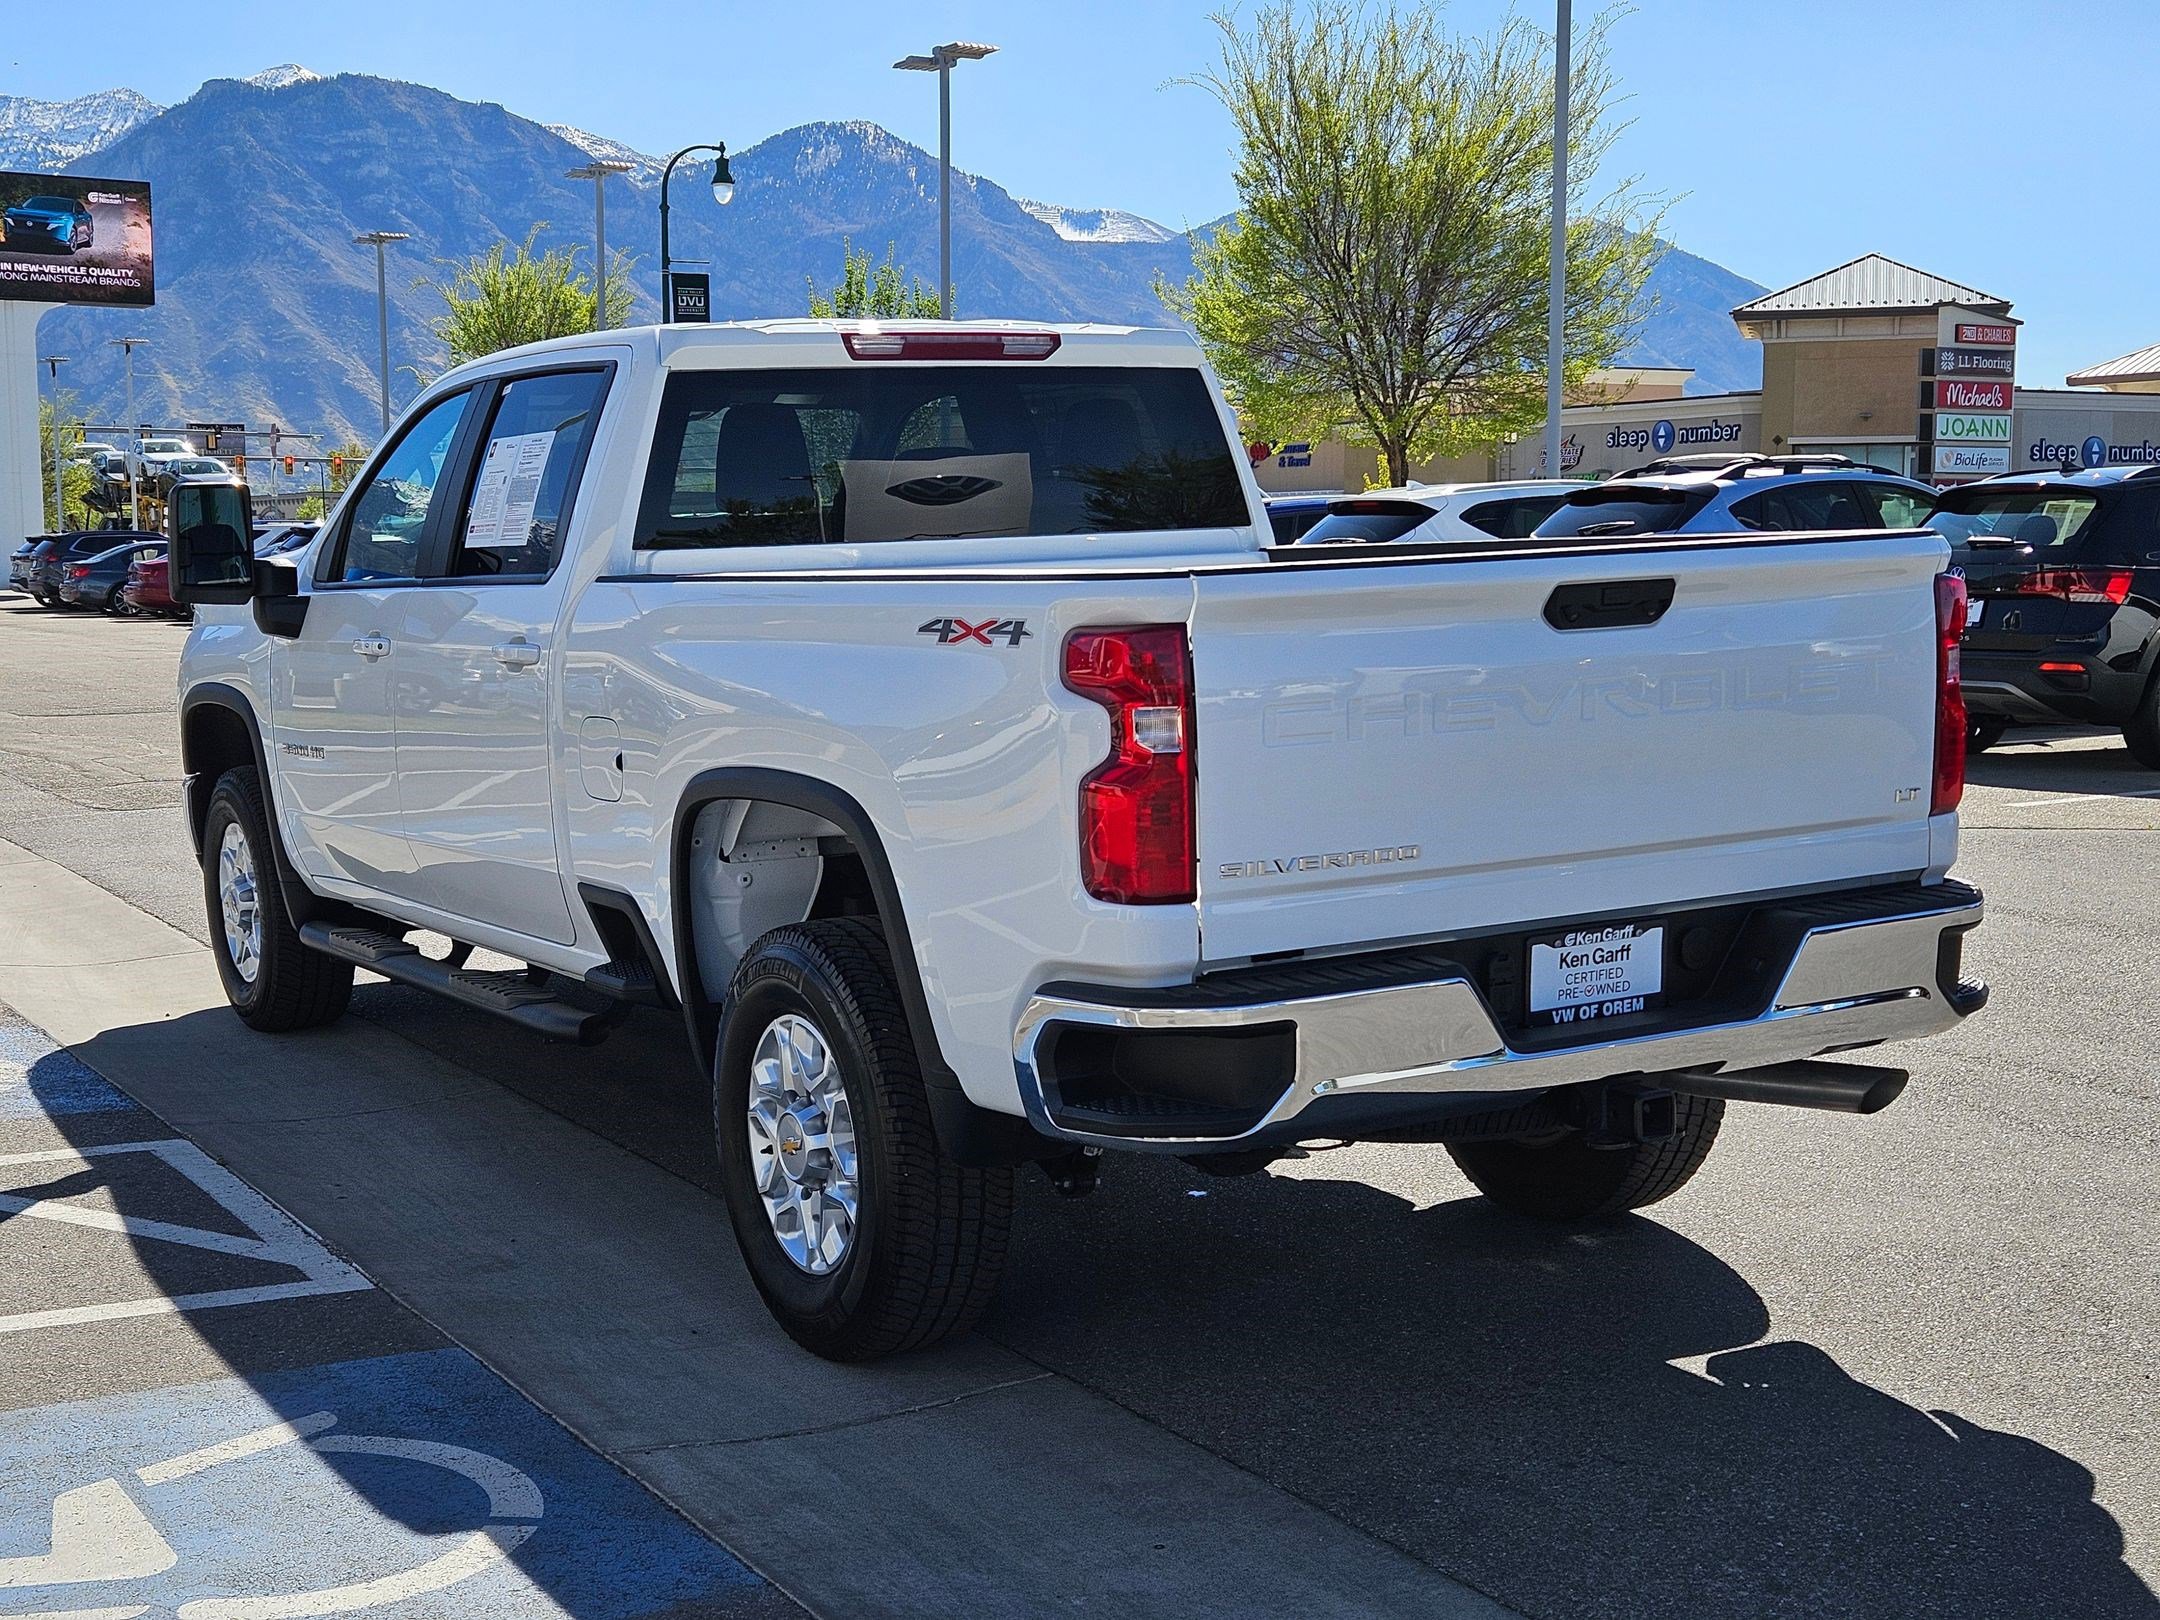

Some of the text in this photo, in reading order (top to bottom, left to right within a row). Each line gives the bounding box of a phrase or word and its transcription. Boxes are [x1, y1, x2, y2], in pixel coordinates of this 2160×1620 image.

[0, 262, 134, 278] IN NEW-VEHICLE QUALITY
[0, 271, 141, 287] MONG MAINSTREAM BRANDS
[678, 296, 704, 306] UVU
[1962, 326, 2011, 342] 2ND & CHARLES
[1958, 356, 2012, 373] LL Flooring
[1946, 383, 2003, 407] Michaels
[1606, 419, 1741, 452] sleep number
[1940, 417, 2007, 438] JOANN
[1540, 447, 1580, 458] INSTATE
[1954, 452, 1988, 469] BioLife
[2031, 439, 2160, 462] sleep numbe
[1540, 456, 1577, 466] BRIES
[1262, 653, 1897, 748] CHEVROLET
[1895, 787, 1921, 803] LT
[1219, 844, 1420, 879] SILVERADO
[1575, 924, 1635, 946] Ken Garff
[1559, 943, 1632, 970] Ken Garff
[746, 958, 801, 982] MICHELIN
[1564, 966, 1624, 986] CERTIFIED
[1551, 996, 1644, 1025] VW OF OREM
